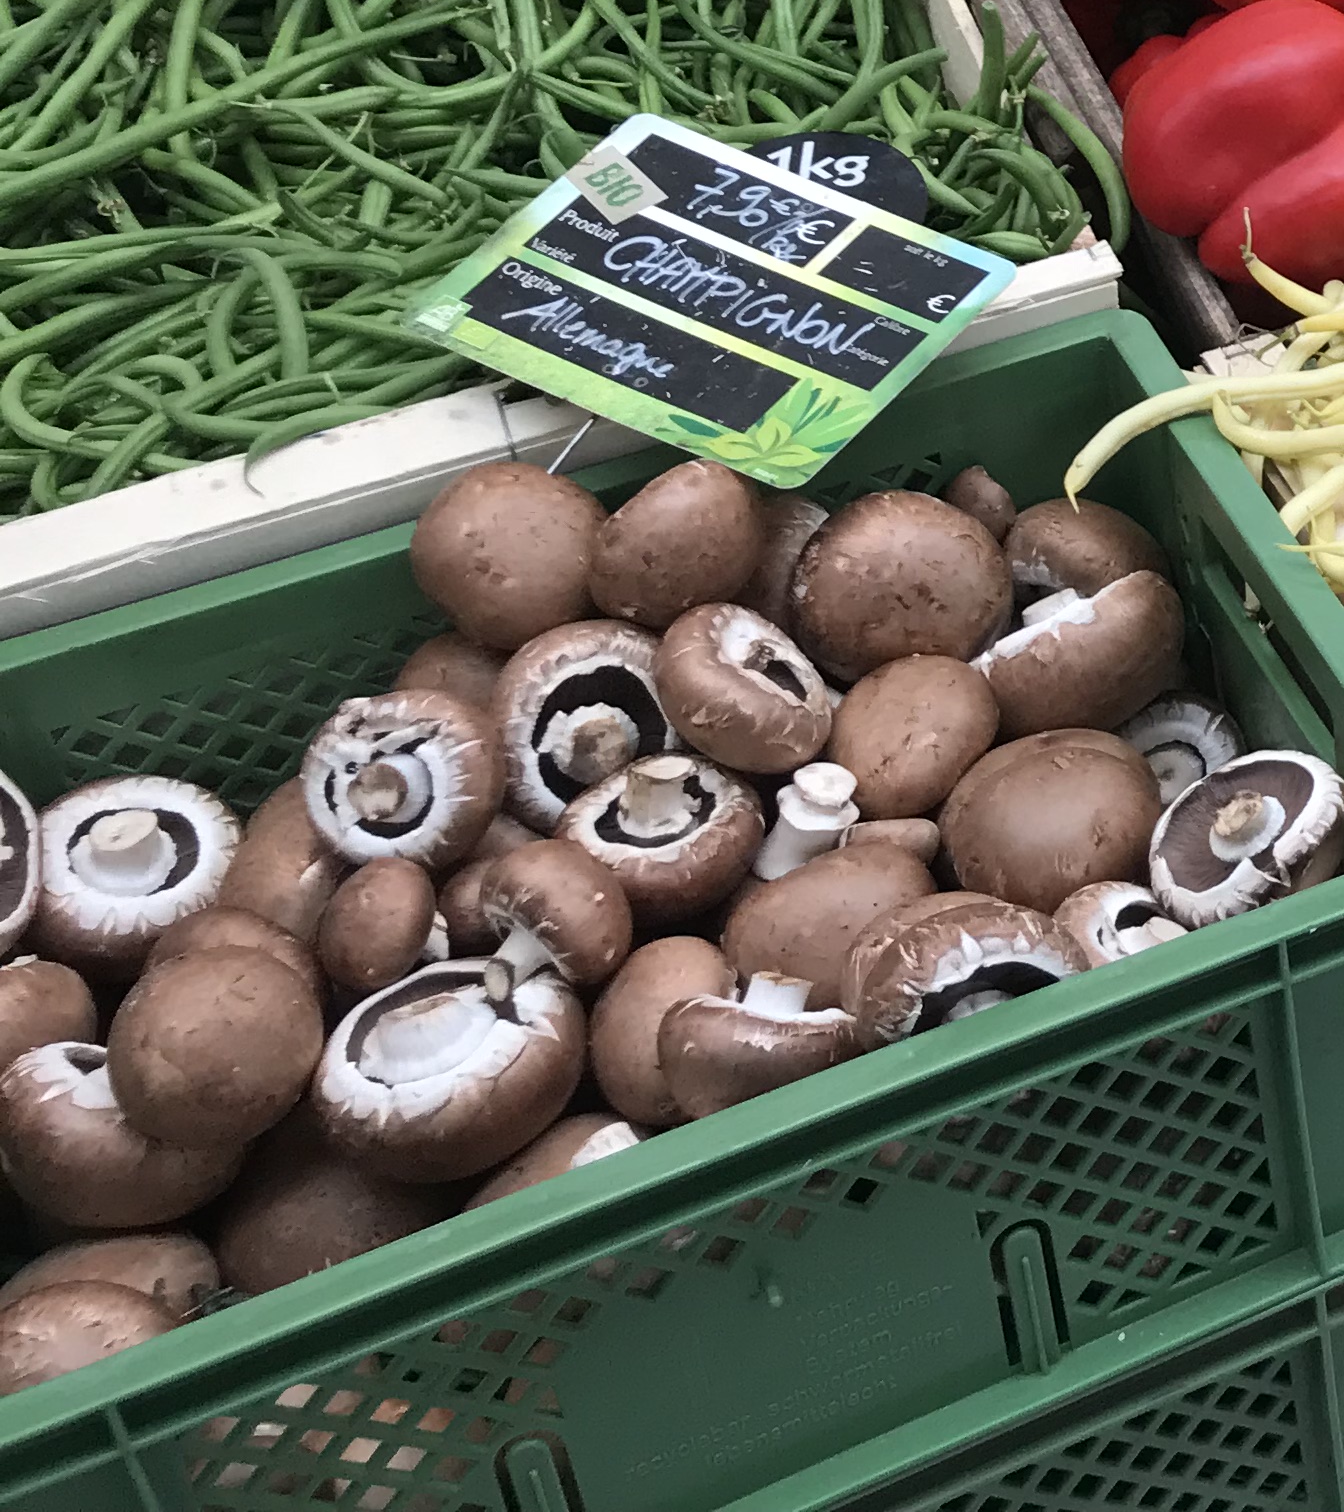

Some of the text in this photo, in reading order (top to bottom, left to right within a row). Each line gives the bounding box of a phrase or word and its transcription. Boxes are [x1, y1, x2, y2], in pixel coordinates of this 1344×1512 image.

[766, 140, 870, 188] 1kg
[584, 161, 644, 207] BIO
[557, 209, 620, 244] Produit
[797, 220, 835, 245] €
[530, 237, 578, 264] Variété
[501, 261, 563, 296] Origine
[603, 234, 876, 357] CHAMPIGNON
[926, 294, 956, 314] €
[500, 296, 679, 381] Allemagne
[873, 316, 911, 336] Calibre
[848, 342, 890, 367] atégorie
